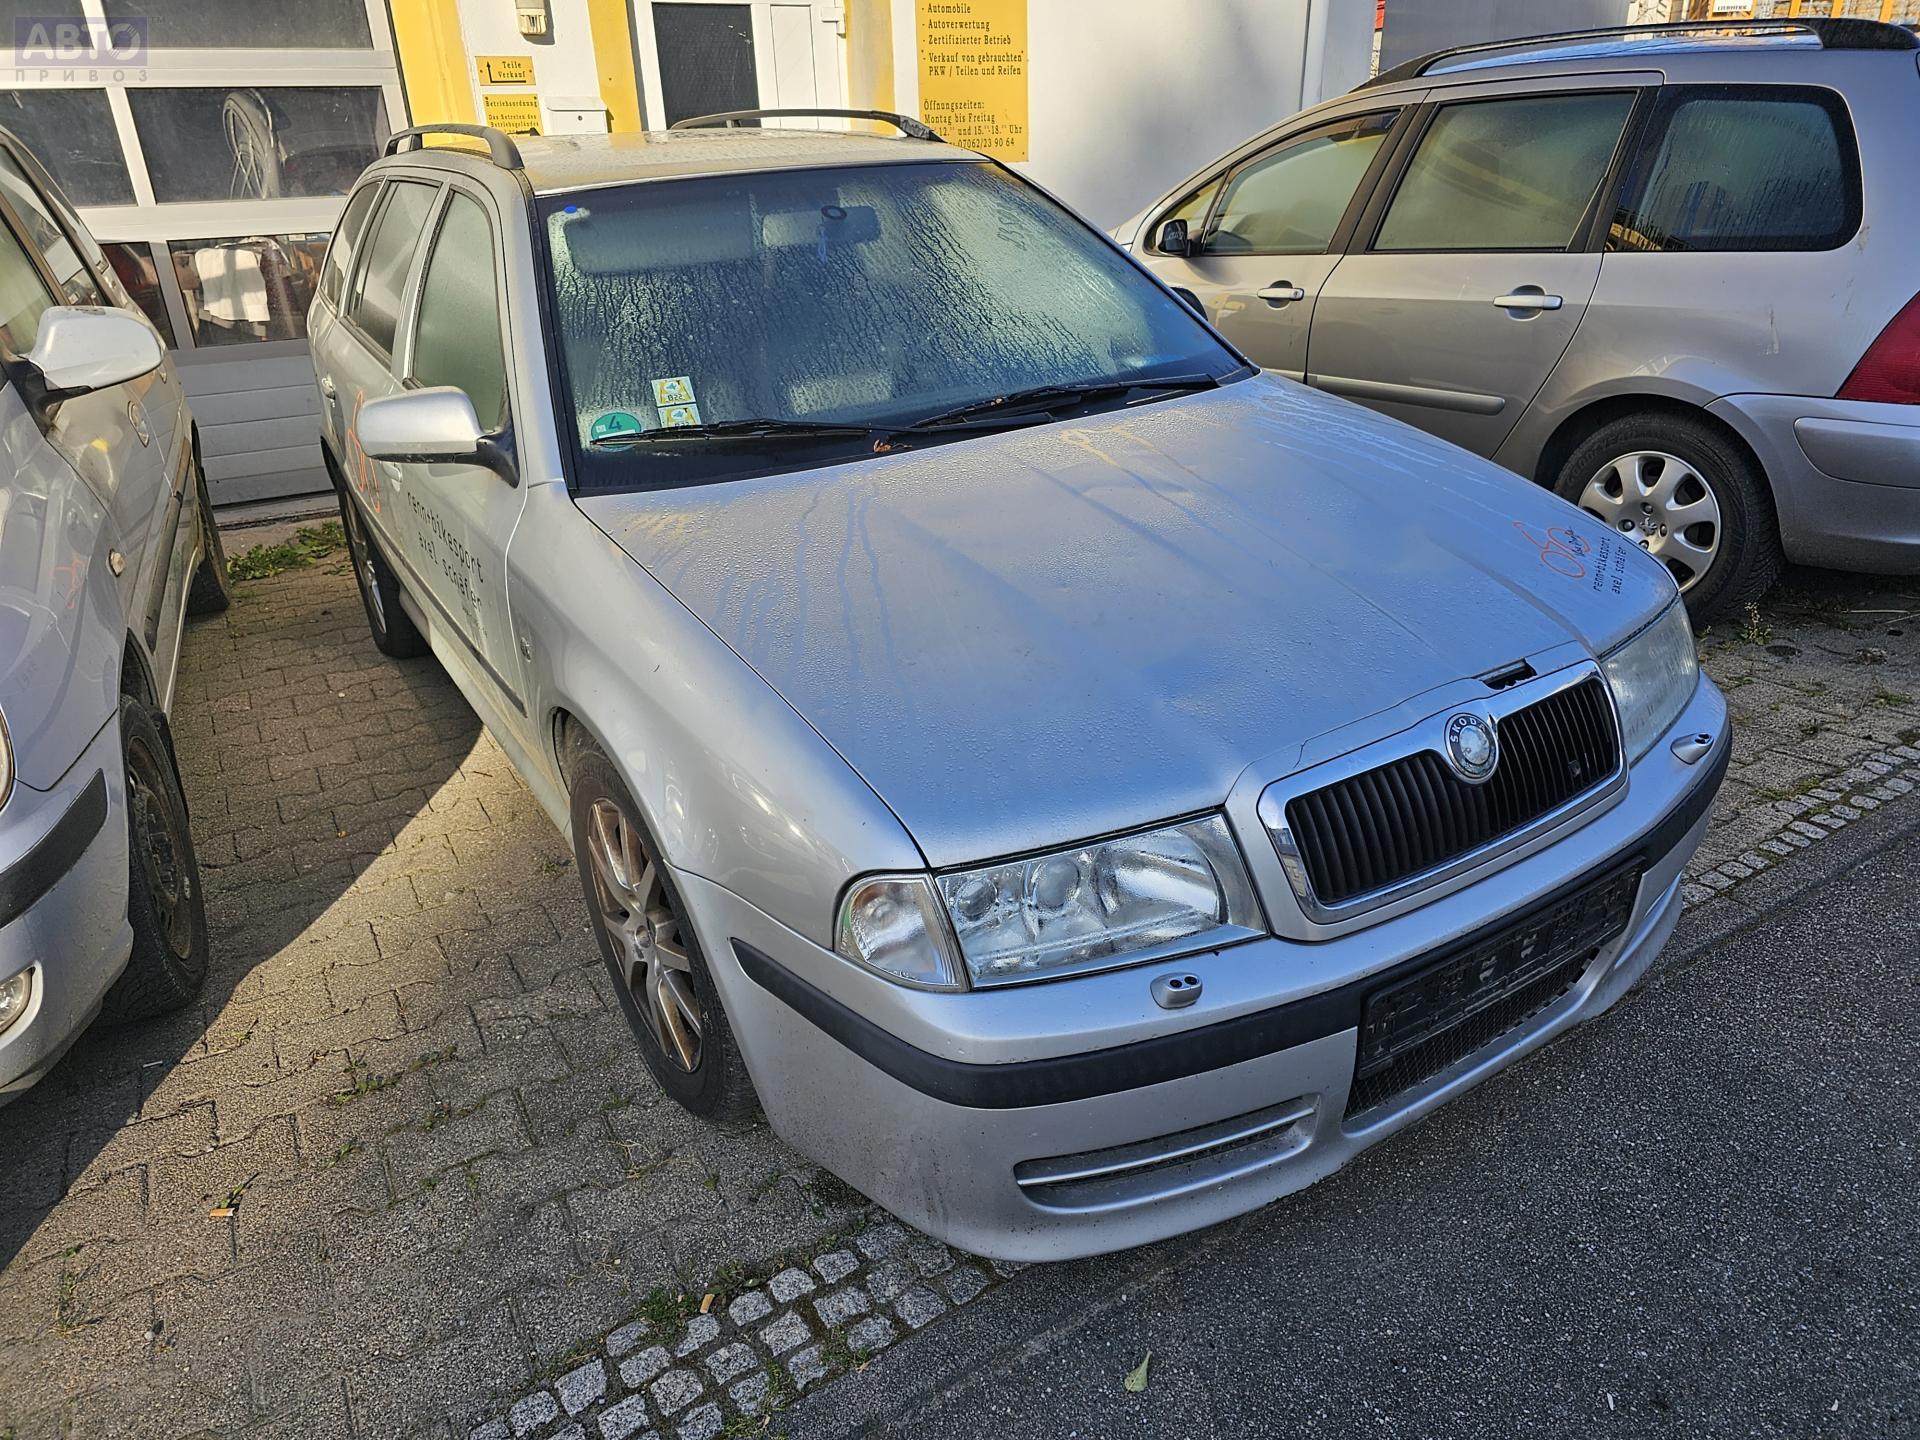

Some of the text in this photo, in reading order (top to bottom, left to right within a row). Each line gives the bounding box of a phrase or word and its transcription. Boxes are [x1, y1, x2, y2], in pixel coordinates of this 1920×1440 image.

[927, 3, 971, 14] Automobile
[928, 19, 990, 31] Autoverwertung
[928, 34, 1011, 45] Zertifizierter Betrieb
[929, 52, 1022, 65] Verkauf von gebrauchten
[502, 61, 522, 69] Teile
[929, 65, 946, 76] PKW
[956, 65, 979, 76] Teilen
[982, 65, 995, 76] und
[998, 65, 1021, 76] Reifen
[498, 70, 526, 78] Verkauf
[924, 98, 985, 112] Öffnungszeiten:
[924, 113, 995, 126] Montag bis Freitag
[957, 127, 972, 136] und
[1009, 124, 1023, 134] Uhr
[994, 137, 1004, 147] 90
[1005, 137, 1015, 147] 64
[608, 415, 623, 431] 4
[418, 532, 439, 565] axel
[1611, 575, 1623, 595] axel
